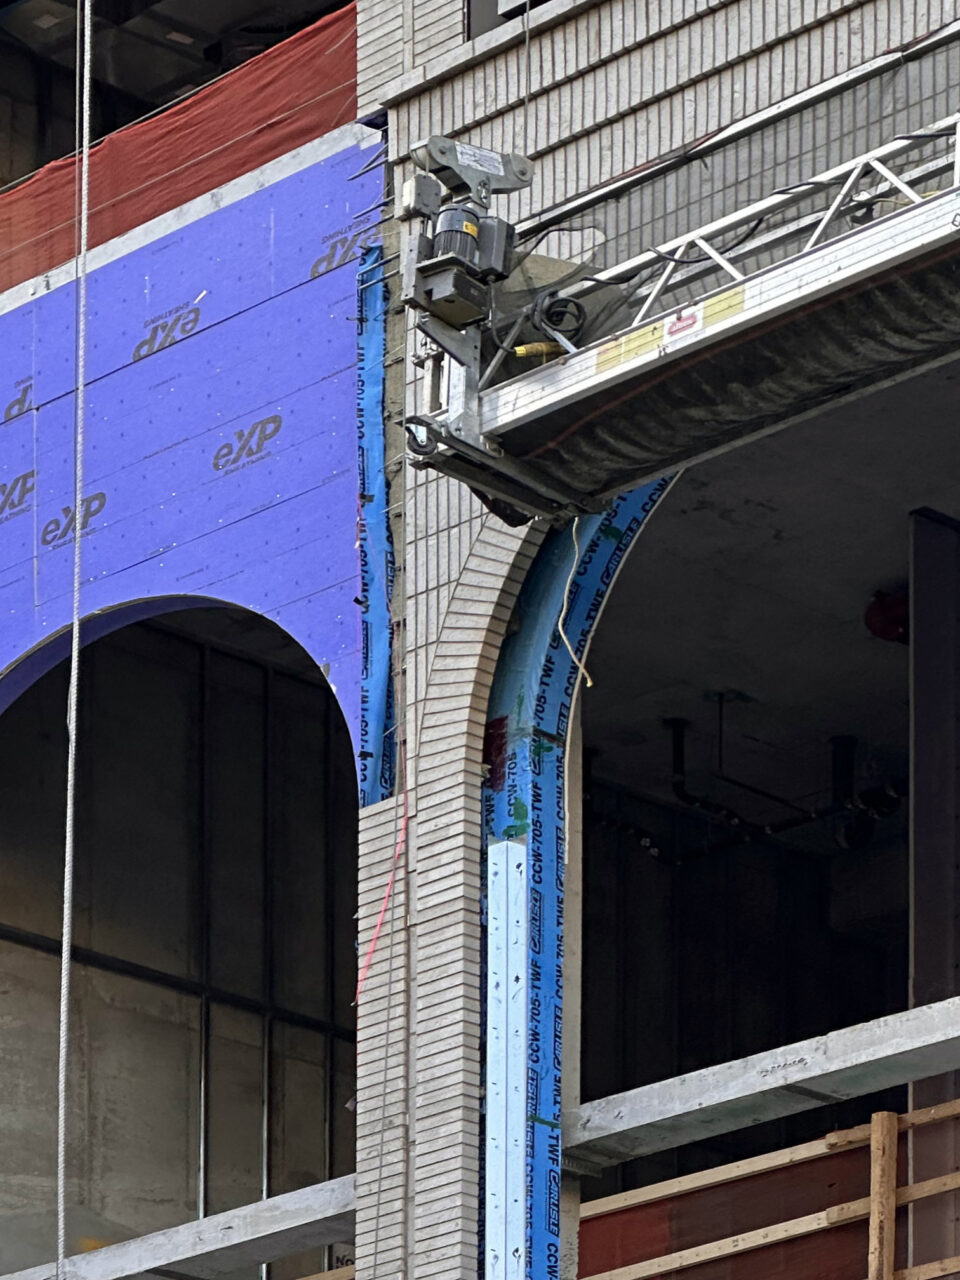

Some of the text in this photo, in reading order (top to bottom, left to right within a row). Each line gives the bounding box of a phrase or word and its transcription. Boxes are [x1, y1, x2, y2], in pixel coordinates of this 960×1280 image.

[212, 414, 282, 472] eXP
[531, 781, 544, 885] CCW-705-TWF
[530, 887, 544, 955] CARLISLE
[529, 959, 542, 1064] CCW-705-TWF
[547, 1168, 561, 1238] CARLISLE
